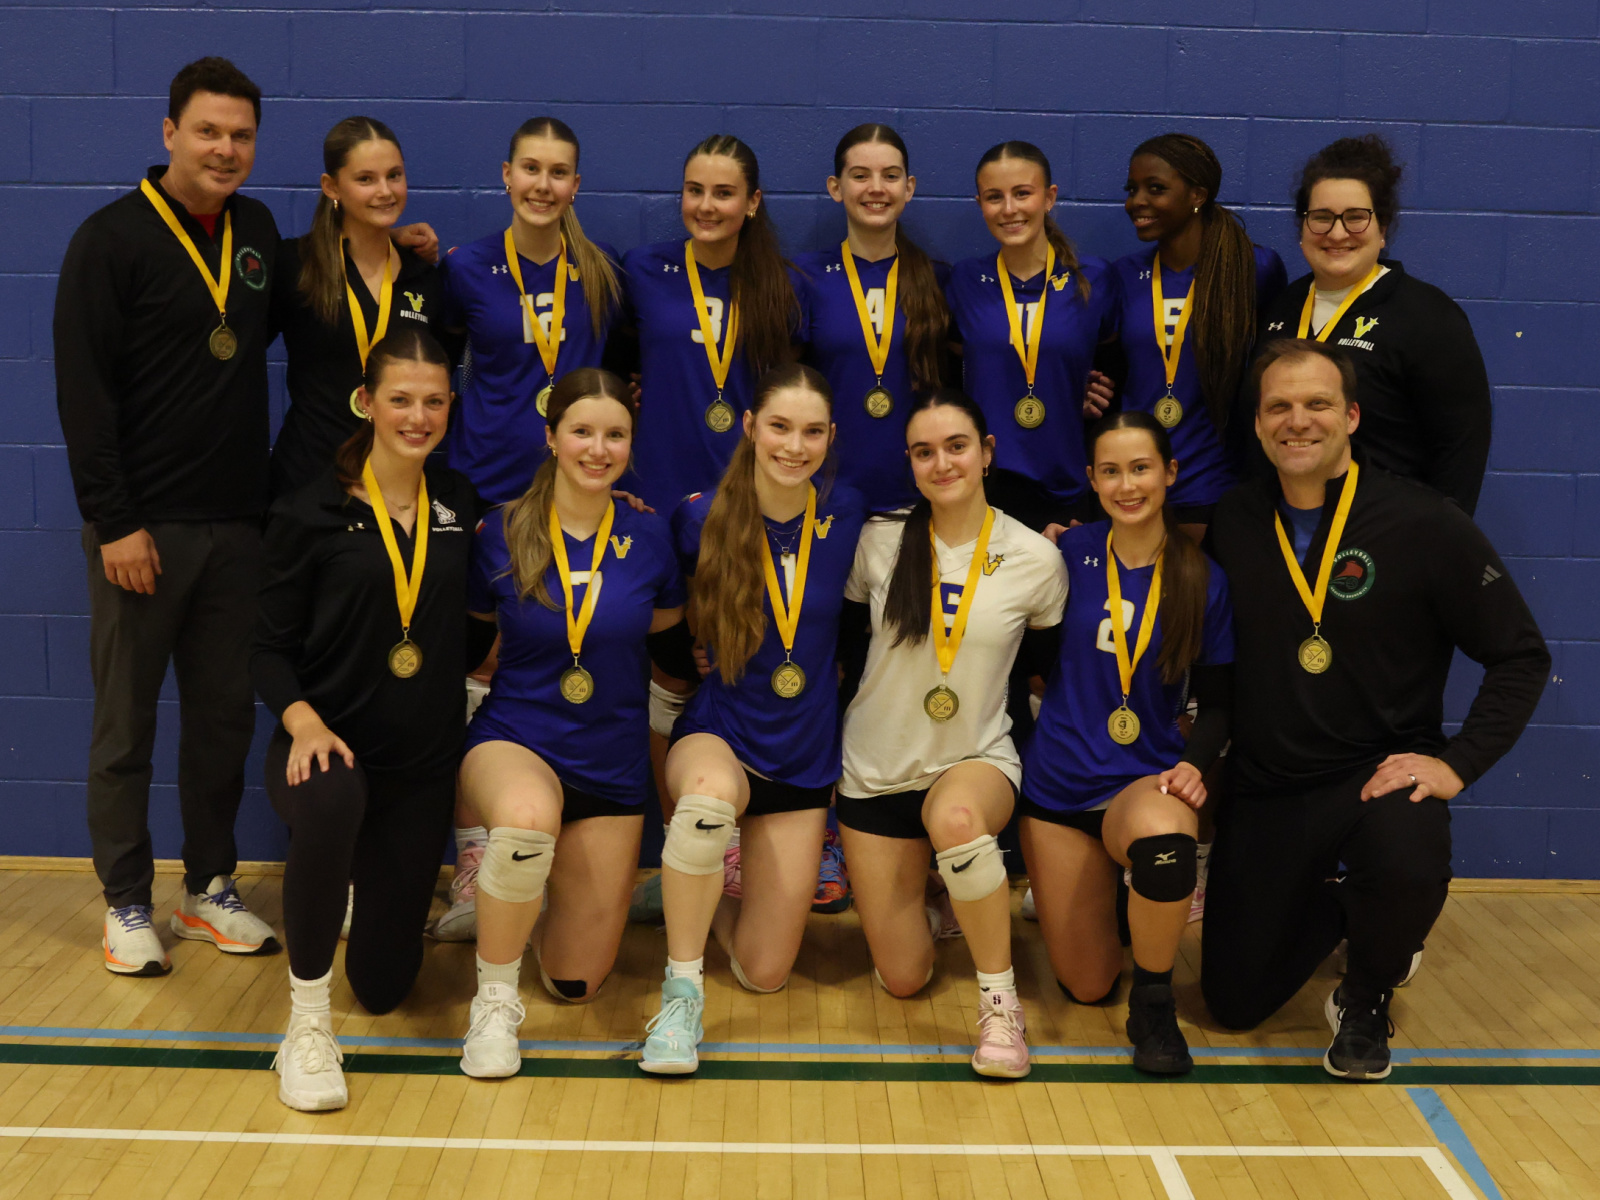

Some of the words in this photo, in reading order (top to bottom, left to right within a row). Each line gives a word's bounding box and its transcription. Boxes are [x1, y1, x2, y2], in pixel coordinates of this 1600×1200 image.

[519, 292, 567, 344] 12
[690, 296, 724, 344] 3
[864, 287, 887, 335] 4
[1338, 338, 1375, 351] VOLLEYBALL
[1332, 549, 1372, 567] VOLLEYBALL
[569, 570, 604, 619] 7
[1096, 598, 1136, 655] 2
